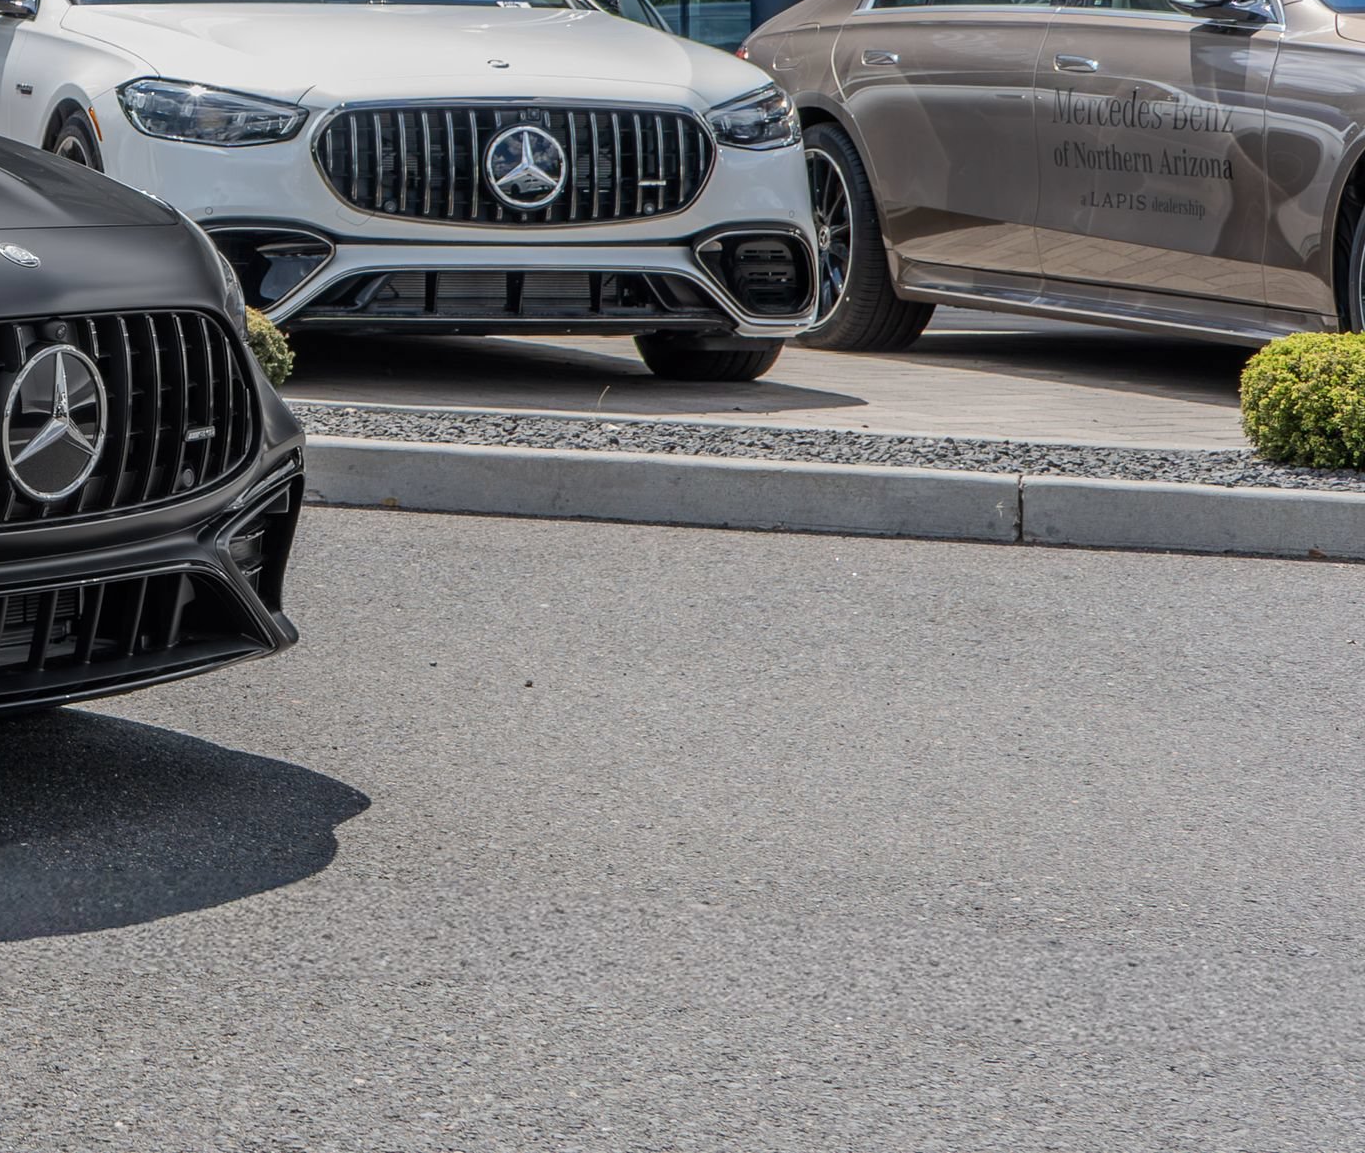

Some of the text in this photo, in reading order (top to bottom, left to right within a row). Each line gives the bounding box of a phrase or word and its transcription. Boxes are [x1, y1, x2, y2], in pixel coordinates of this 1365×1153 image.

[1052, 87, 1234, 133] Mercedes-Benz
[1054, 140, 1234, 180] of Northern Arizona
[1080, 191, 1207, 221] a LAPIS dealership
